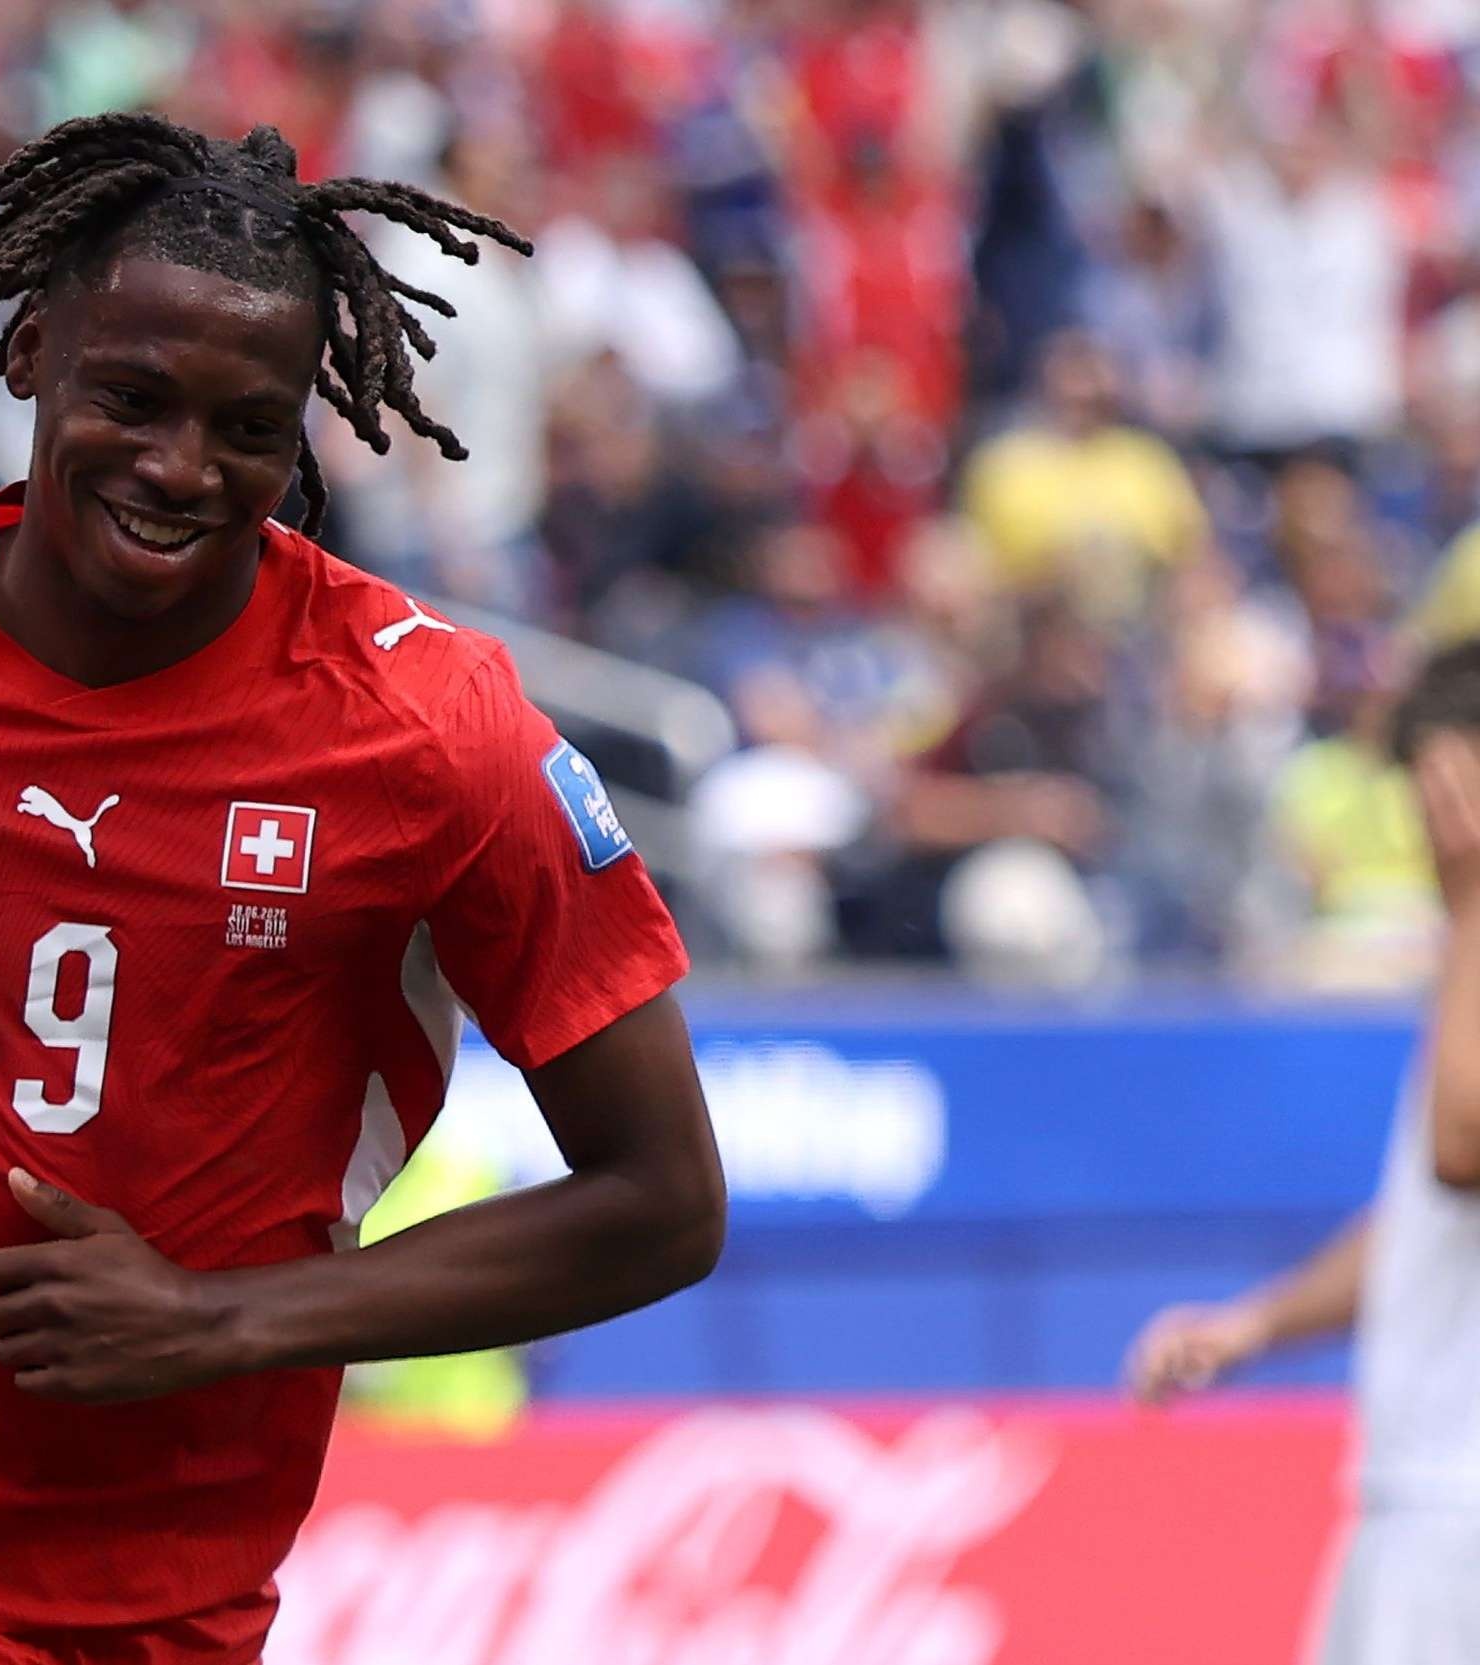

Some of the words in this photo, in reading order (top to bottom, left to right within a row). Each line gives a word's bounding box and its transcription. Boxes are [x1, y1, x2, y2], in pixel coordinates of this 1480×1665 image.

[227, 915, 250, 934] SUI
[264, 919, 287, 936] BIH
[225, 932, 243, 946] LOS
[245, 934, 288, 949] ANGELES
[12, 921, 119, 1134] 9
